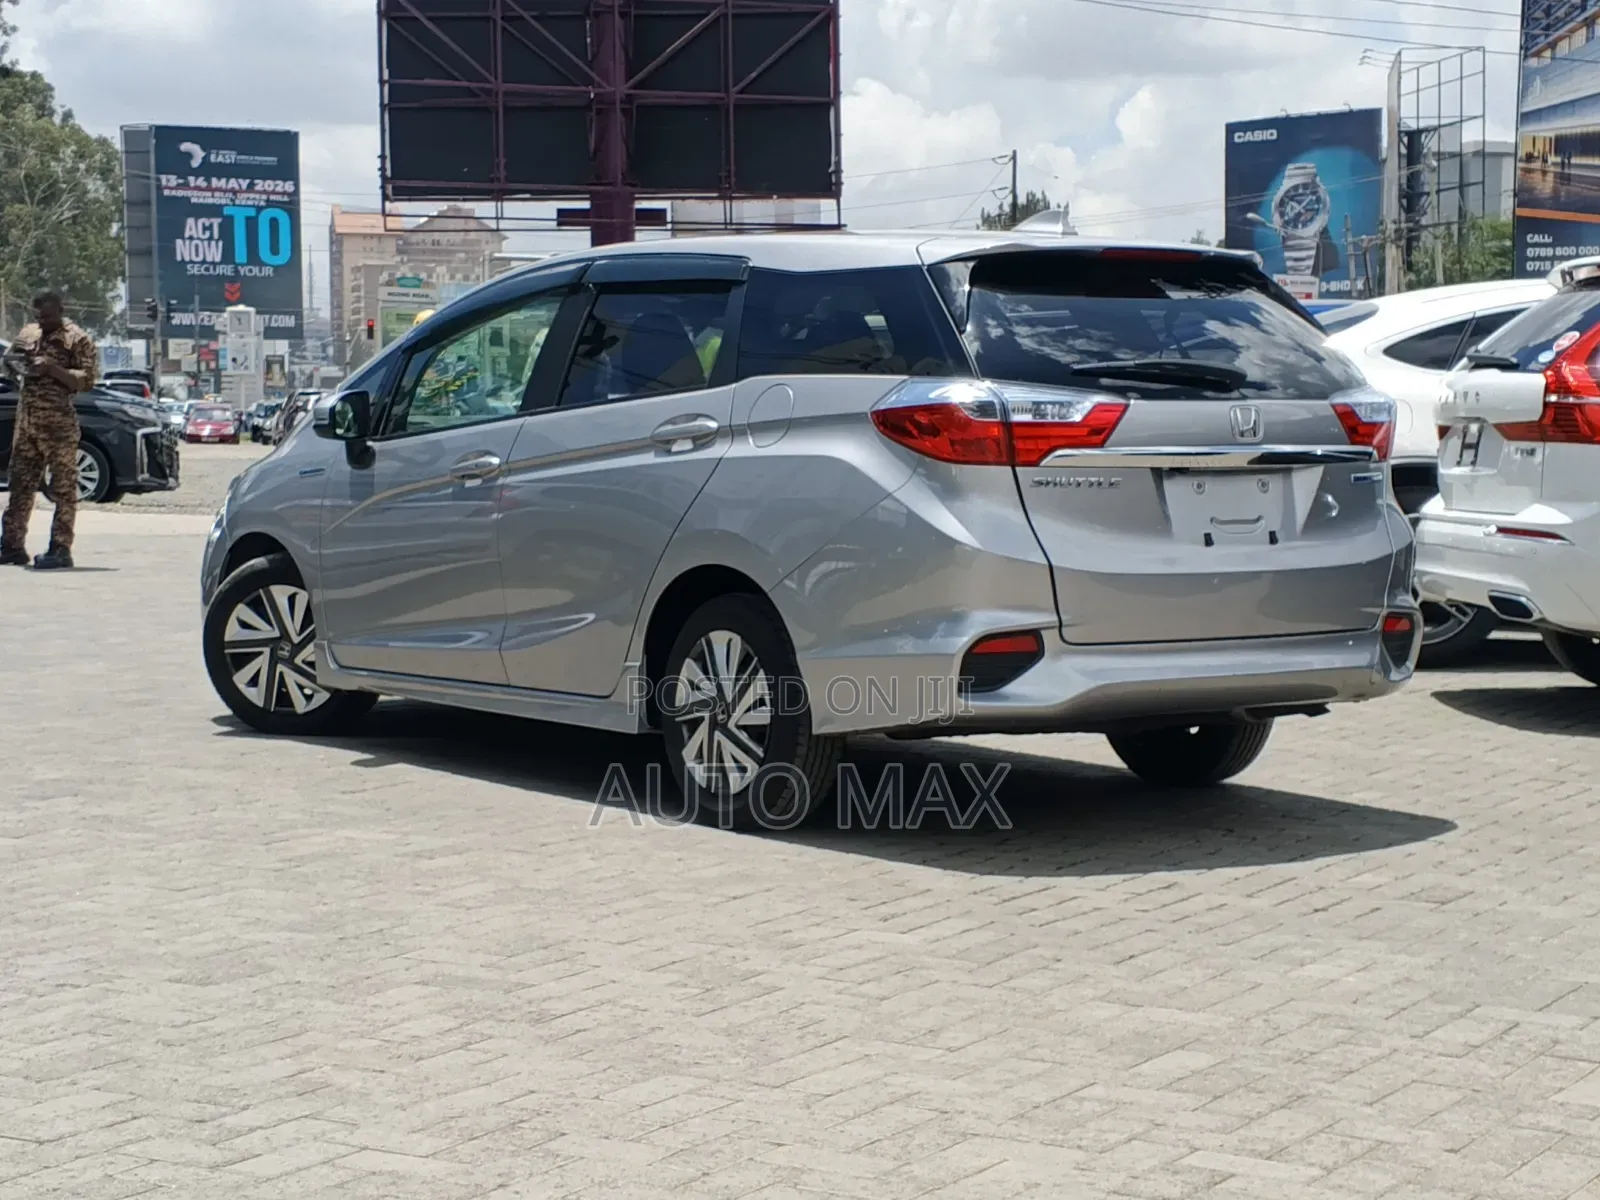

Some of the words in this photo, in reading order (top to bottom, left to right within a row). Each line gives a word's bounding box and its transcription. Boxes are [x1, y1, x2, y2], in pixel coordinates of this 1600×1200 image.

[1233, 129, 1278, 143] CASIO
[209, 153, 236, 165] EAST
[187, 175, 208, 188] 14
[211, 177, 251, 190] MAY
[254, 179, 295, 193] 2026
[184, 217, 222, 240] ACT
[223, 206, 292, 267] TO
[175, 239, 223, 263] NOW
[186, 264, 235, 276] SECURE
[238, 265, 273, 277] YOUR
[1030, 476, 1123, 489] SHUTTLE
